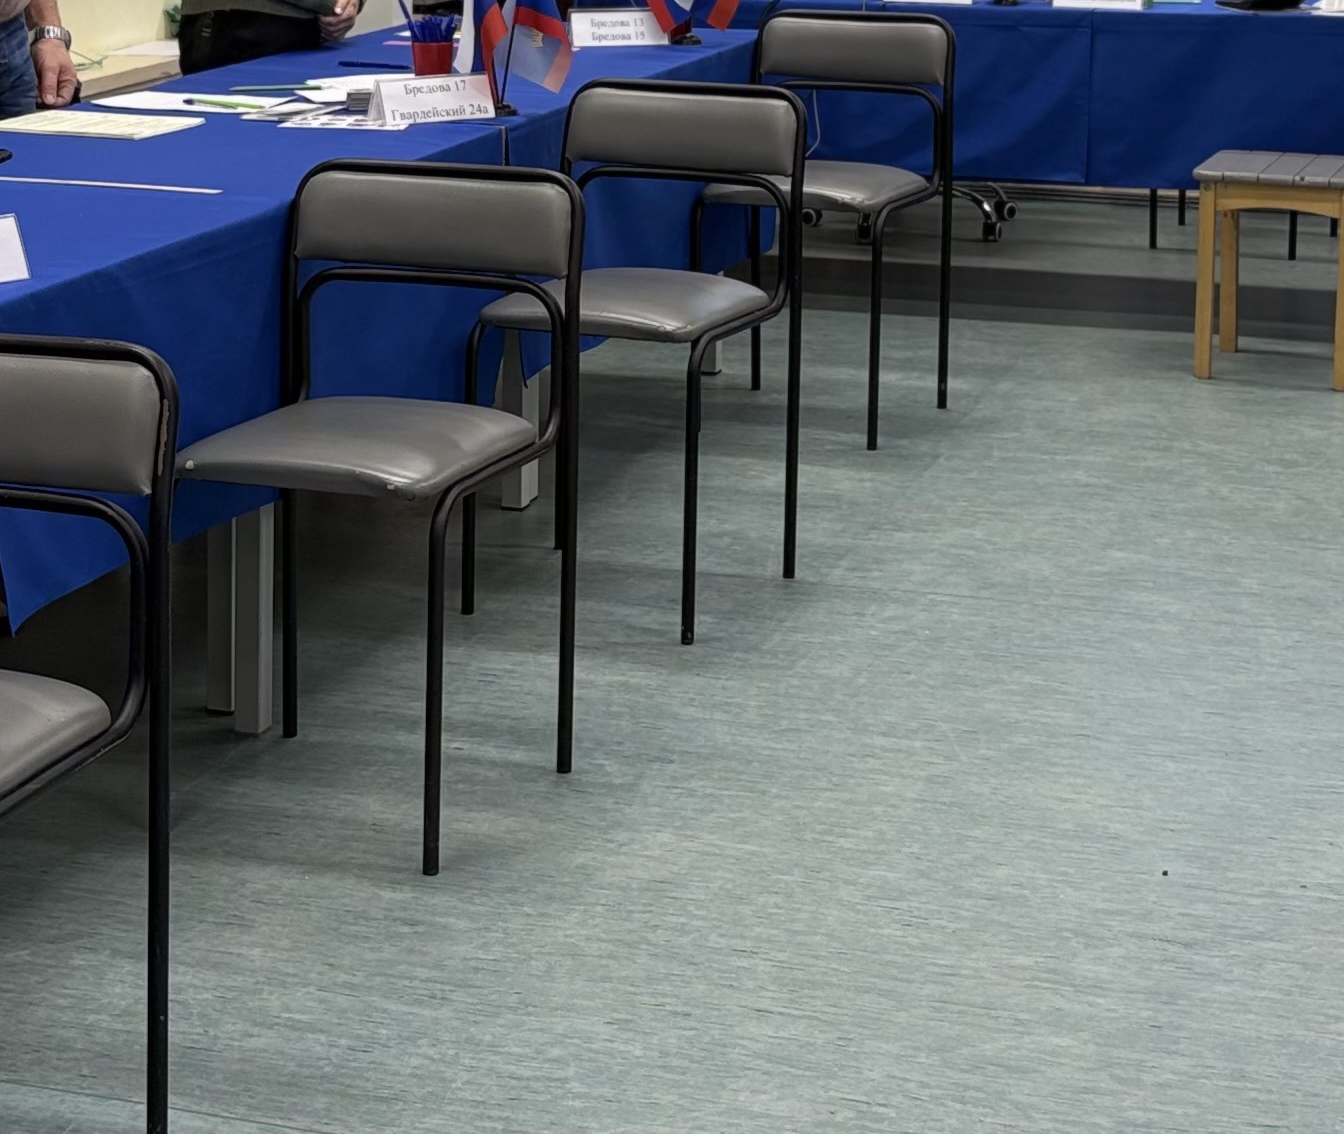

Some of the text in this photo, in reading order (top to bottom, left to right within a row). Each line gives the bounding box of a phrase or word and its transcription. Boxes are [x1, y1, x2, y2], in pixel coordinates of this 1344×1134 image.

[590, 17, 645, 30] Бредова 13
[591, 31, 646, 43] Бредова 15
[404, 80, 467, 97] Бредова 17
[391, 103, 490, 122] Гвардейский 24а
